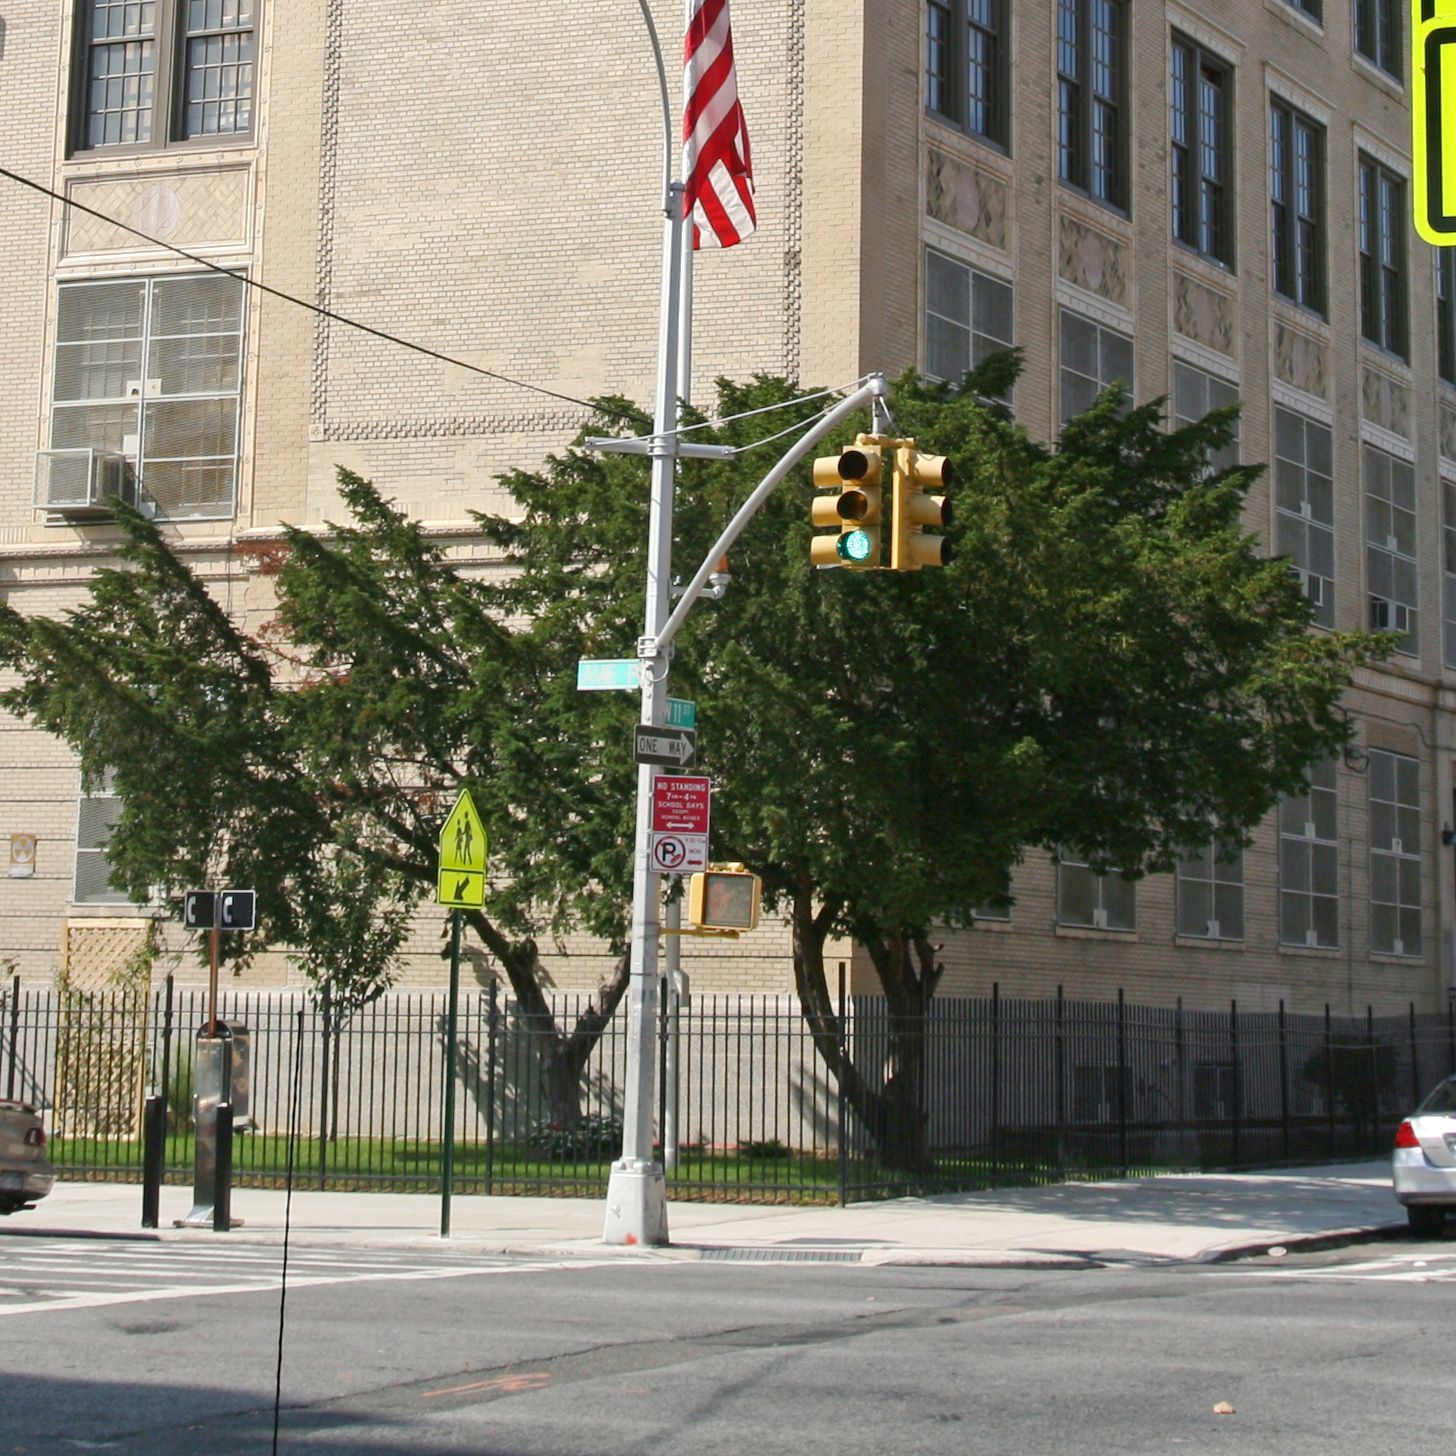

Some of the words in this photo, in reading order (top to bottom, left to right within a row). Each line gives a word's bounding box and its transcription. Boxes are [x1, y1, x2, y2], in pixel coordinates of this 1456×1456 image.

[639, 738, 657, 753] ONE
[668, 741, 686, 756] WAY
[657, 782, 668, 790] NO
[671, 783, 706, 792] STANDING
[658, 801, 684, 809] SCHOOL
[686, 802, 705, 810] DAYS
